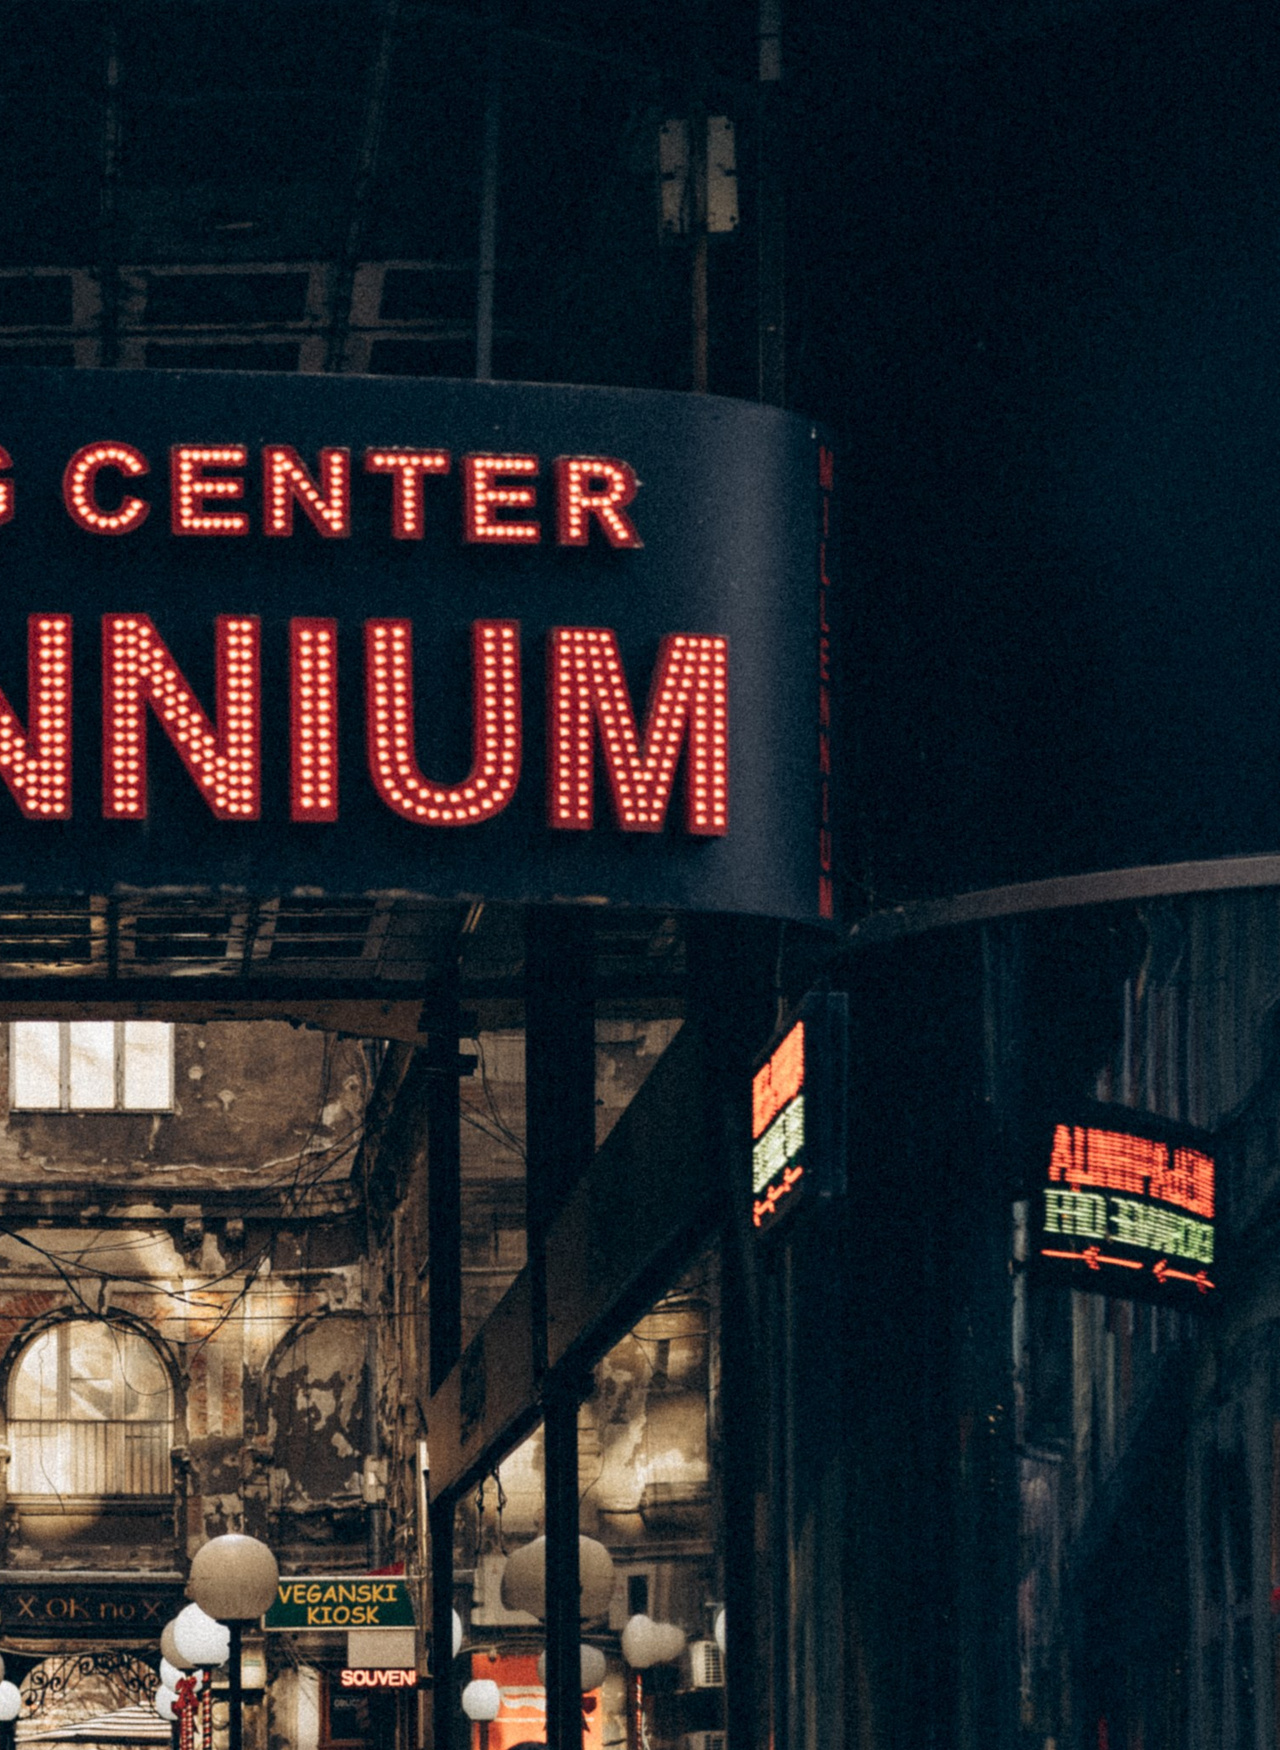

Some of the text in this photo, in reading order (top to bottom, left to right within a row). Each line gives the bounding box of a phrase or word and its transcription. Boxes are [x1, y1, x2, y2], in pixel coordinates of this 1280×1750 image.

[62, 440, 645, 549] CENTER
[278, 1583, 398, 1605] VEGANSKI
[306, 1605, 380, 1625] KIOSK
